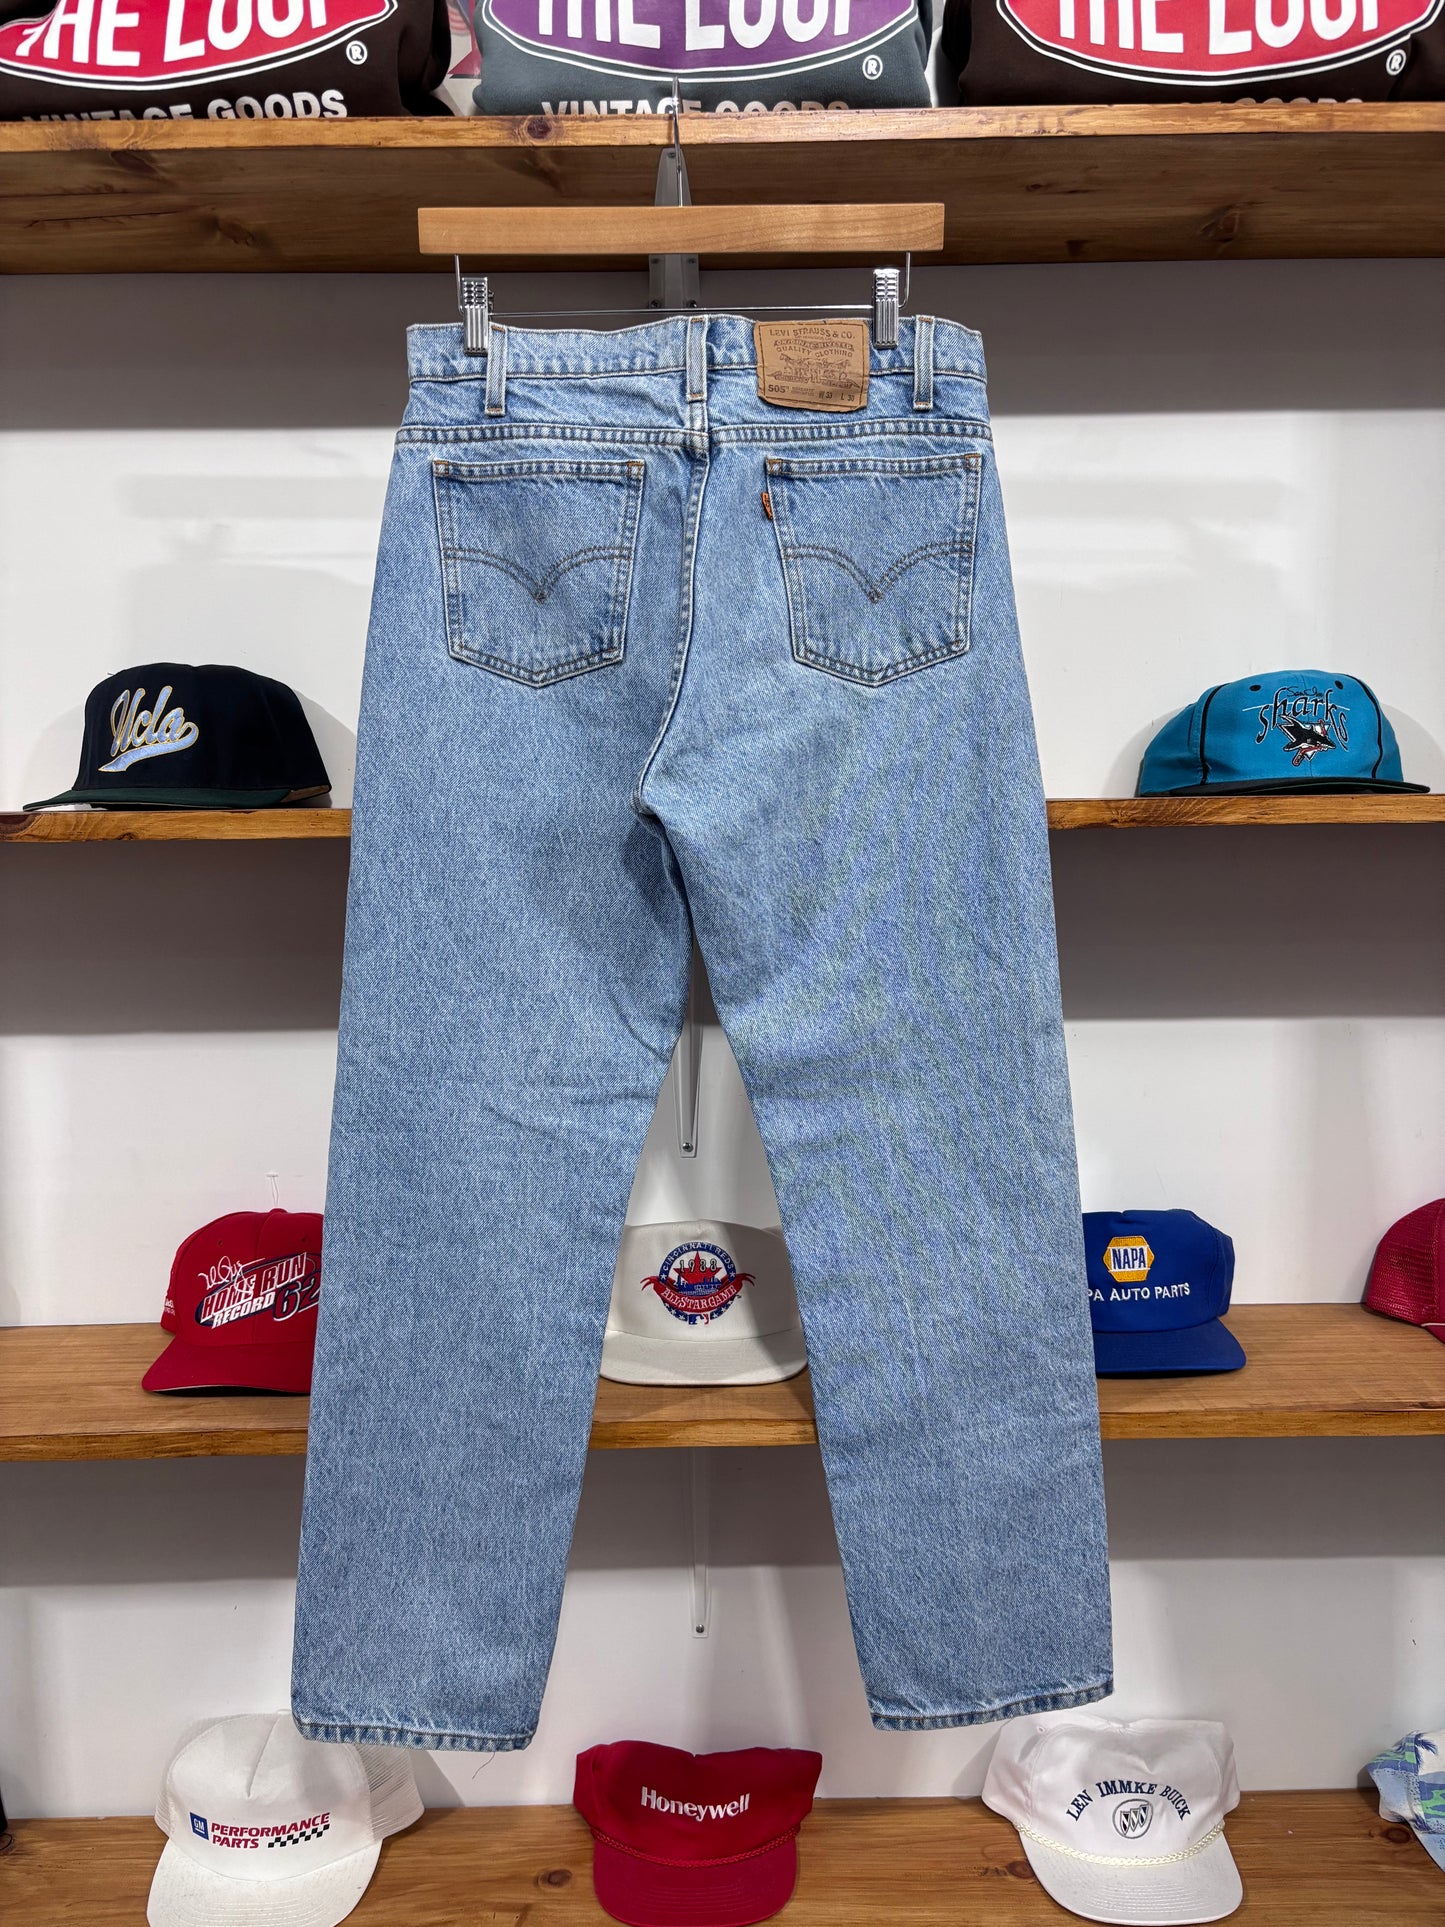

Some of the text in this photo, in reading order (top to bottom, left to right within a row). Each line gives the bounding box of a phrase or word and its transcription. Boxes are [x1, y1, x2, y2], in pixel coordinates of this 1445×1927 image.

[769, 329, 790, 337] LEVI
[793, 327, 831, 338] STRAUSS
[776, 346, 853, 358] QUALITY CLOTHING
[1112, 1247, 1147, 1270] NAPA
[200, 1273, 257, 1324] HOME
[260, 1252, 307, 1296] RUN
[1087, 1282, 1191, 1302] PA AUTO PARTS
[212, 1291, 276, 1330] RECORD
[273, 1270, 321, 1322] 62
[640, 1785, 751, 1822] Honeywell
[1066, 1779, 1191, 1821] LEN IMMKE BUICK
[193, 1817, 206, 1832] GM
[211, 1812, 331, 1838] PERFORMANCE
[212, 1834, 260, 1849] PARTS
